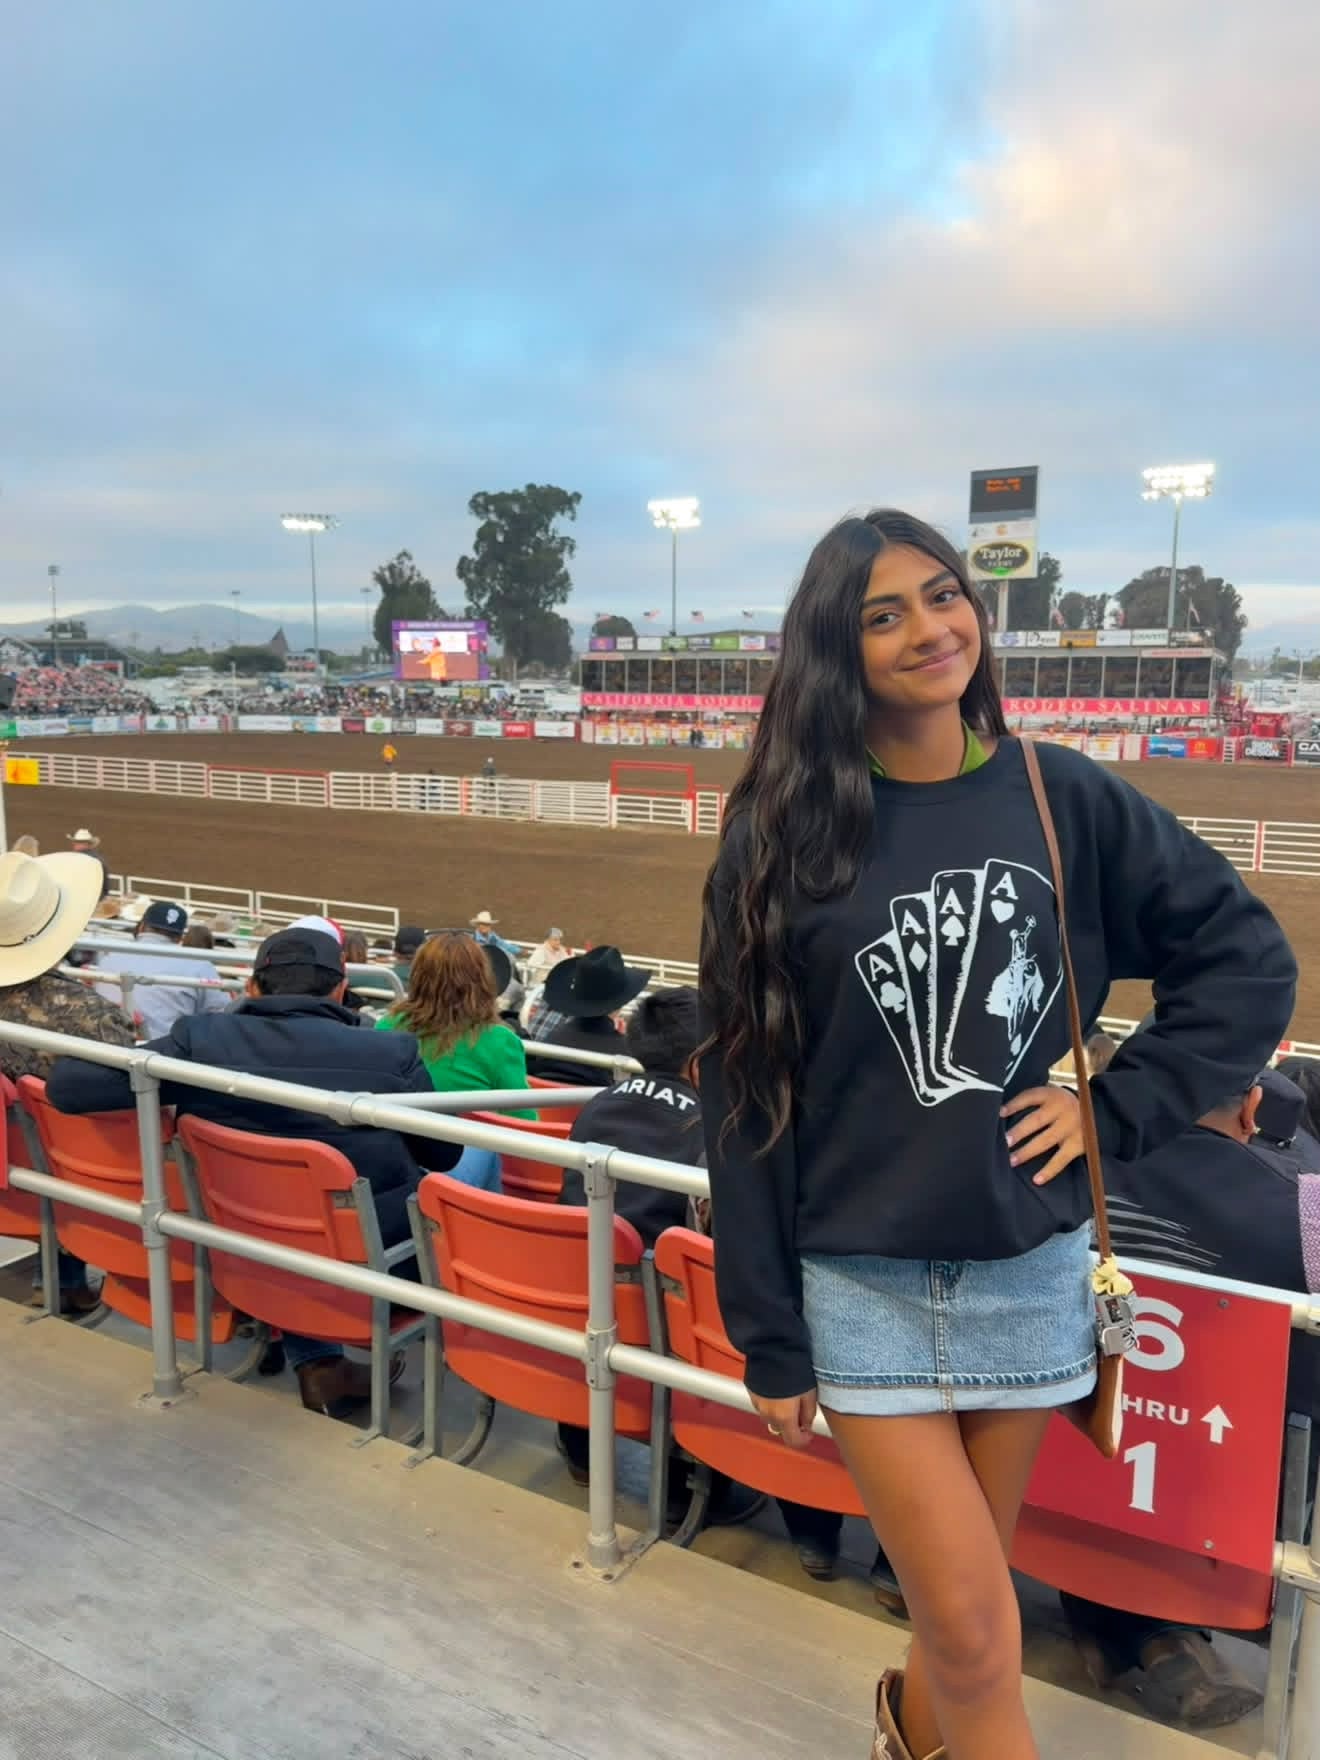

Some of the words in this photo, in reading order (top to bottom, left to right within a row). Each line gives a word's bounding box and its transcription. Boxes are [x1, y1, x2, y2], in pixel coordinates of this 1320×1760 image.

[980, 547, 1022, 560] Taylor
[583, 694, 685, 706] CALIFORNIA
[1009, 699, 1085, 712] RODEO
[1097, 700, 1201, 713] SALINAS
[990, 871, 1019, 900] A
[939, 887, 966, 915] A
[901, 909, 926, 937] A
[868, 953, 895, 982] A
[612, 1079, 696, 1111] ARIAT
[1122, 1296, 1185, 1371] 6
[1121, 1393, 1190, 1426] HRU
[1123, 1440, 1157, 1514] 1
